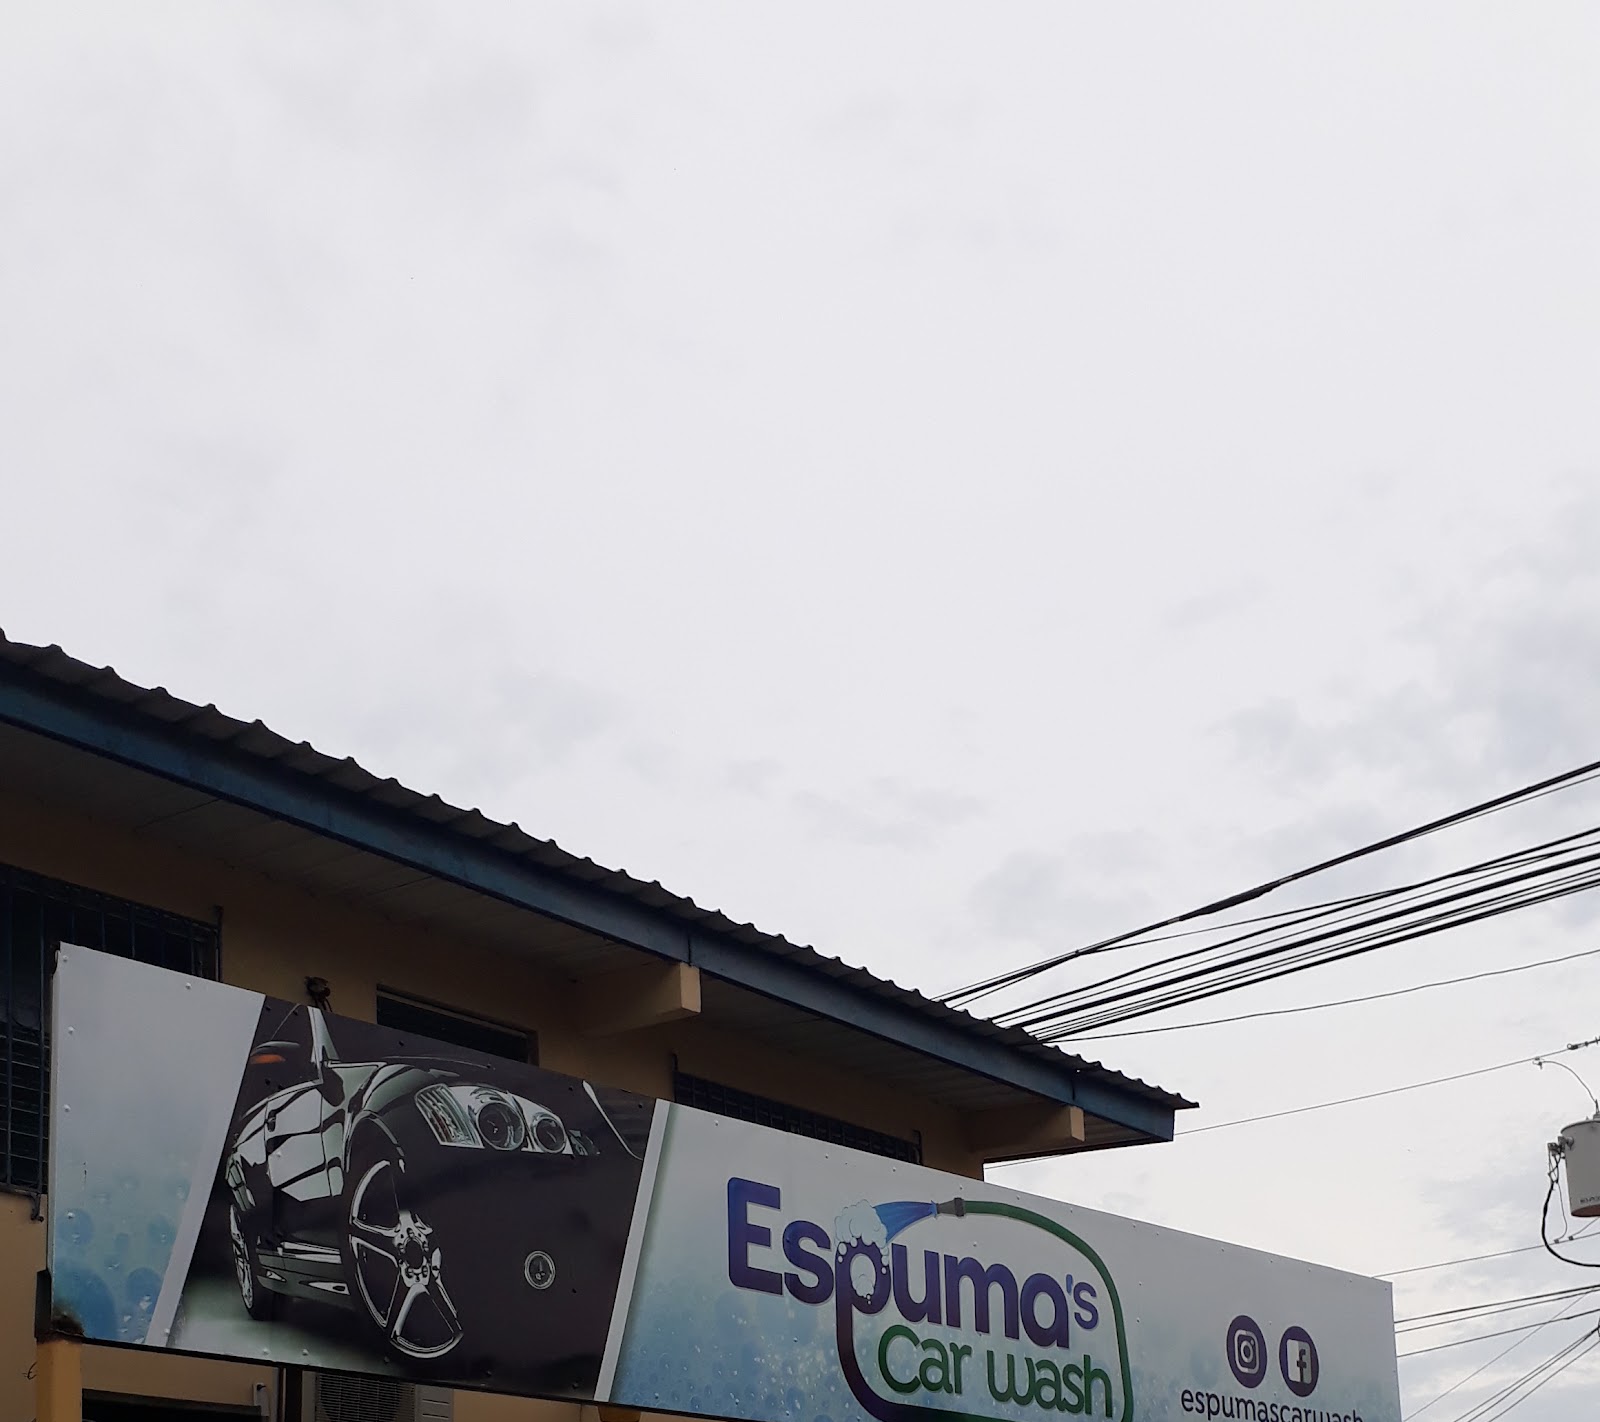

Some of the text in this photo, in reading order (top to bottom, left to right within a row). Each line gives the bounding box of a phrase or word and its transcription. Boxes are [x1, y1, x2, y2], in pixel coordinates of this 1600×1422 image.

[727, 1177, 1099, 1348] Espuma's
[878, 1324, 1113, 1418] Car wash
